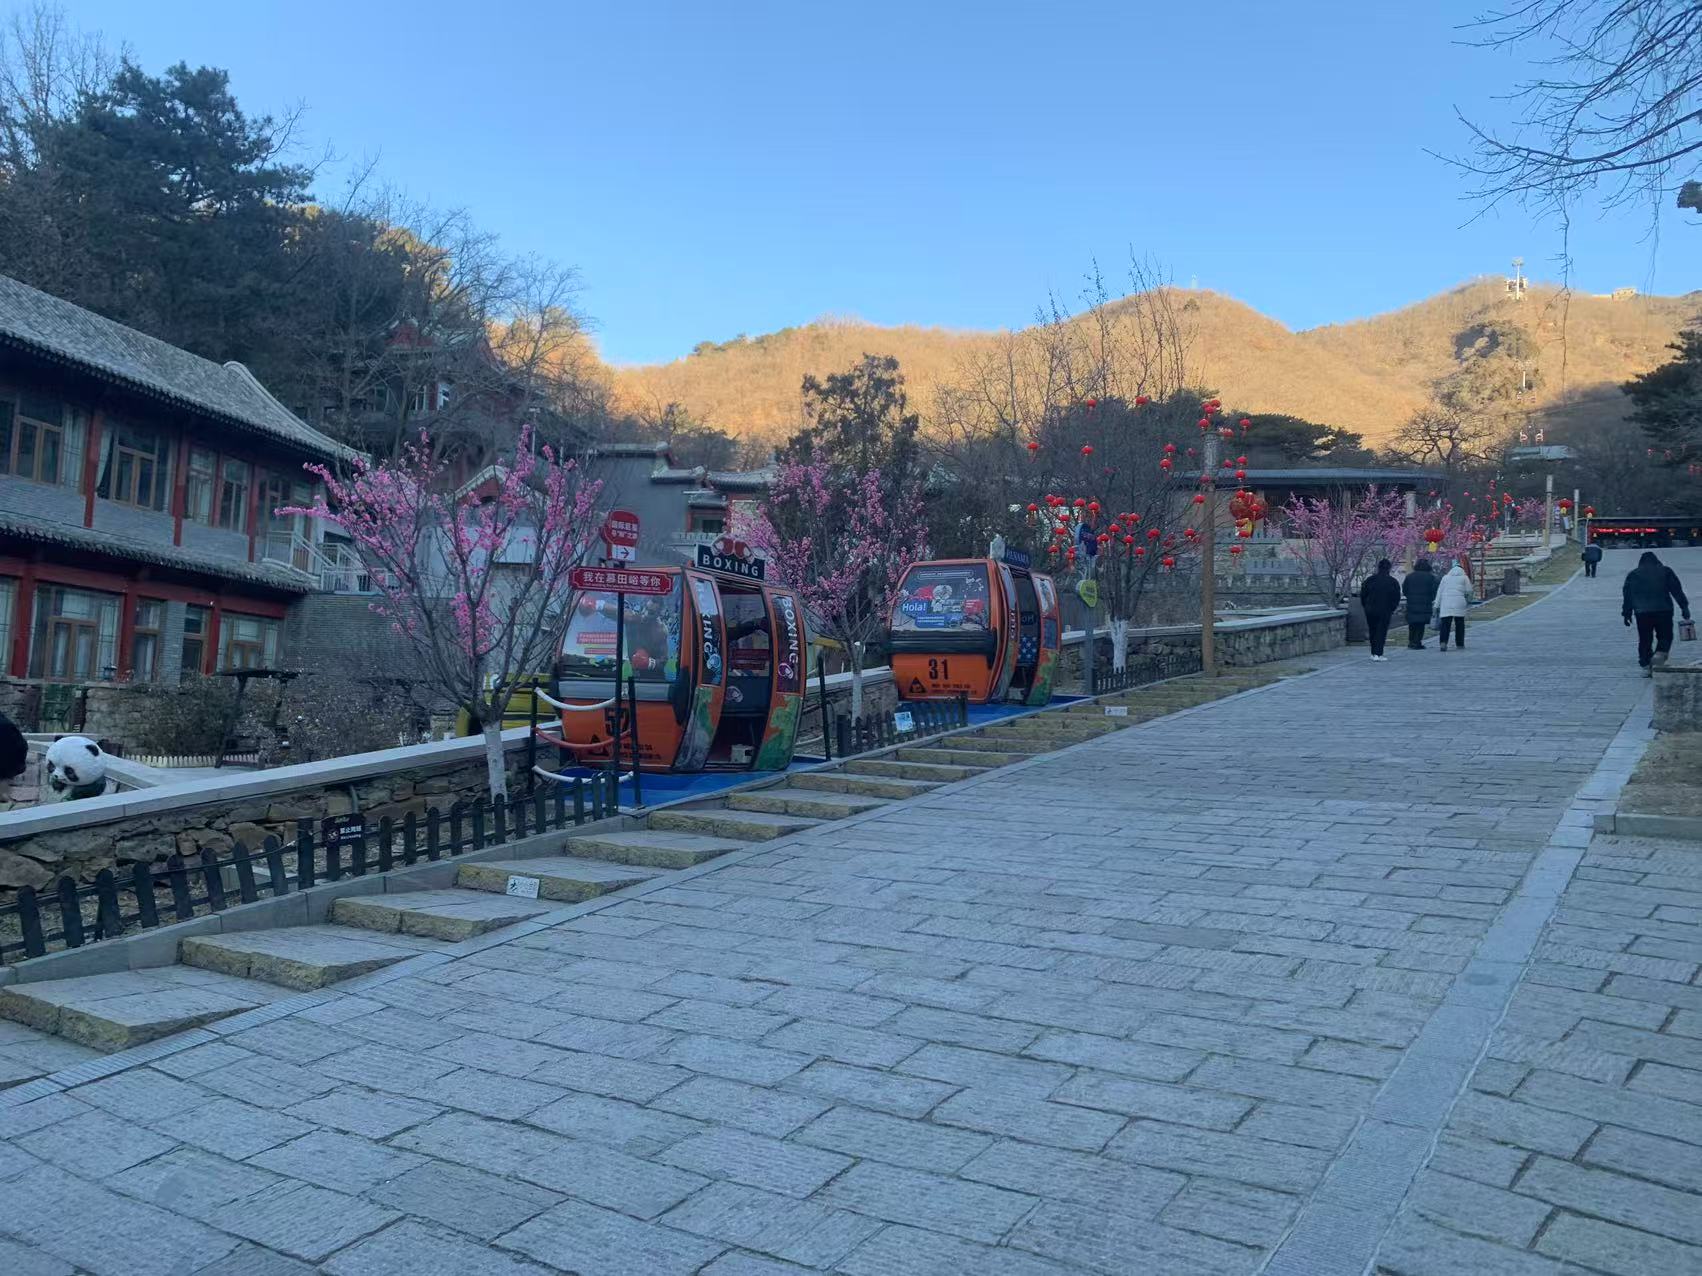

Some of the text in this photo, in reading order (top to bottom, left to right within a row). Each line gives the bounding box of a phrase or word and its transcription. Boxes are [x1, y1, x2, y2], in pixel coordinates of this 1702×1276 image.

[702, 554, 759, 576] BOXING
[583, 571, 661, 587] 我在慕田峪等你
[902, 602, 927, 612] Hola!
[782, 598, 799, 664] BOXING
[928, 658, 948, 680] 31
